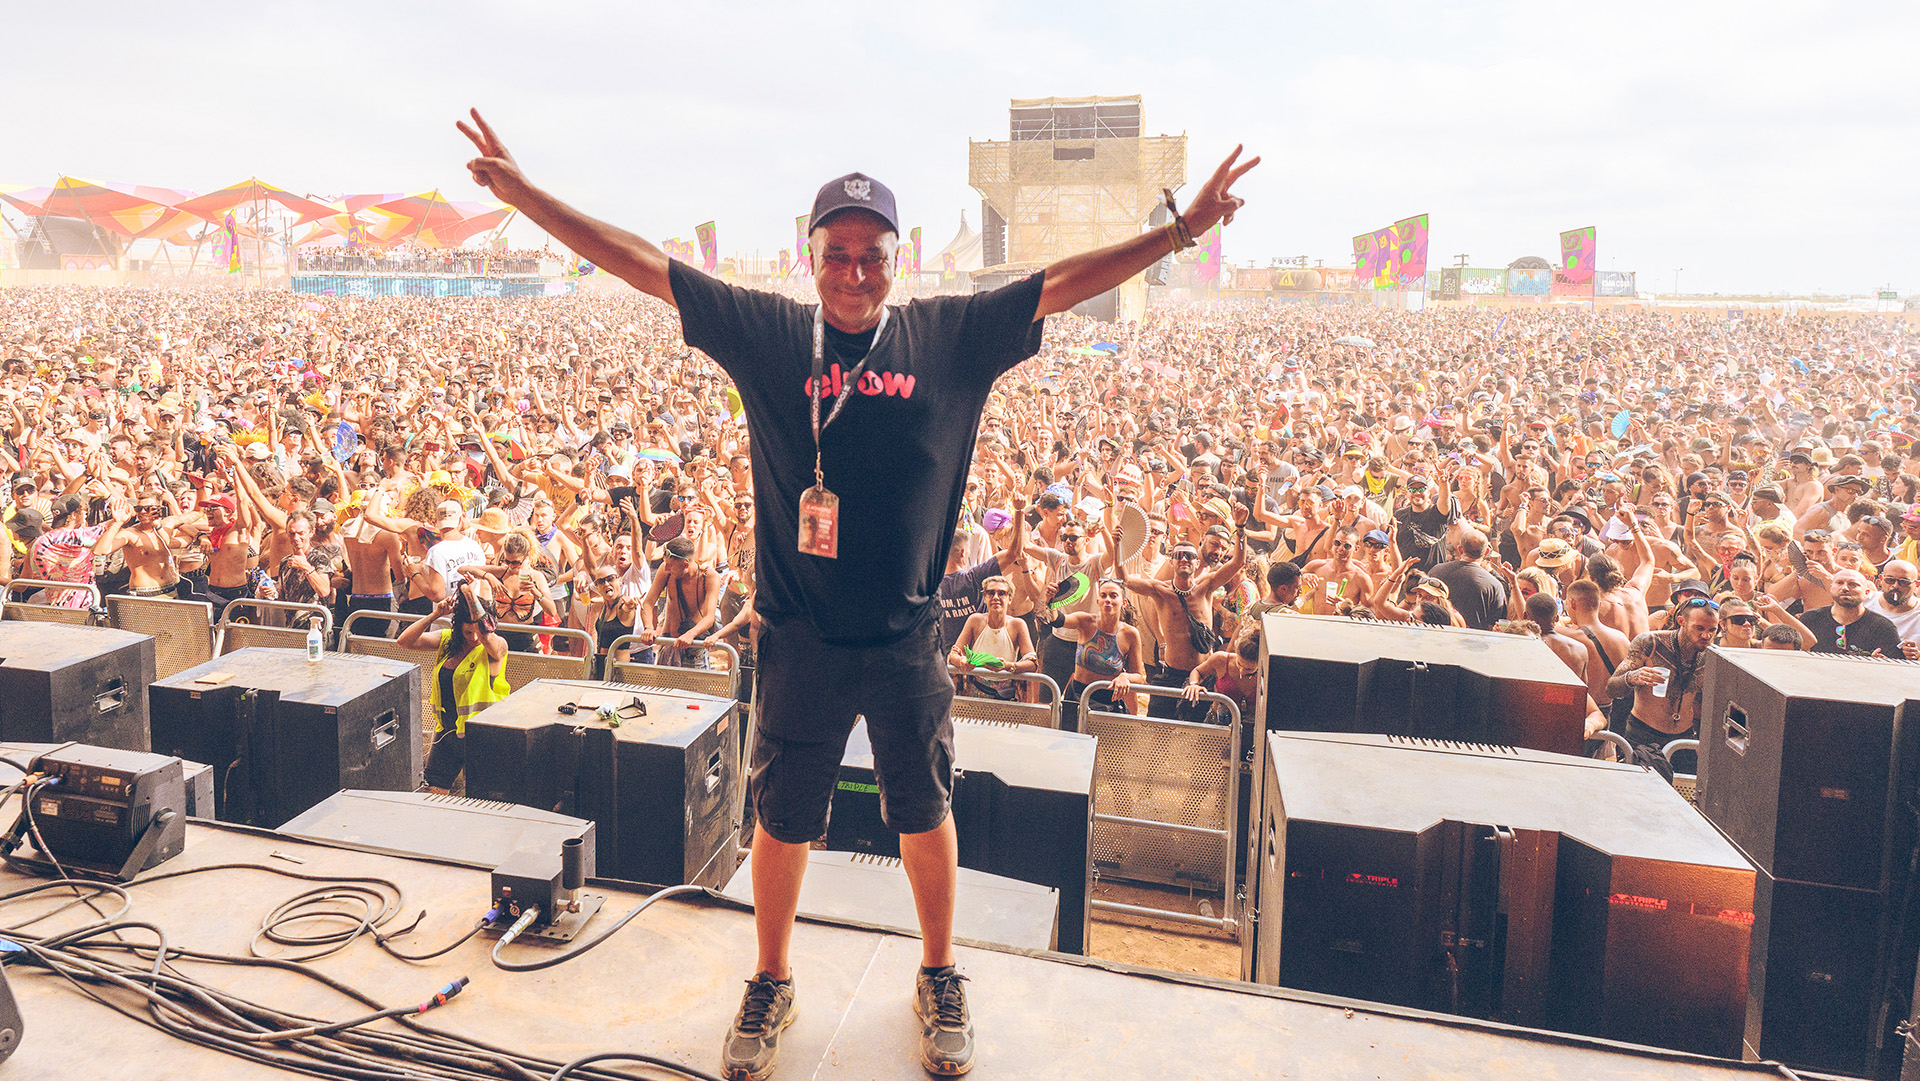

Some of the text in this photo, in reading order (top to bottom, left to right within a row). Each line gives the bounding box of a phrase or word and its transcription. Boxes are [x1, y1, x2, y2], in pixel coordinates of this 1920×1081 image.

[952, 604, 976, 618] RAVE!
[1366, 874, 1398, 885] TRIPLE
[1631, 895, 1668, 906] TRIPLE
